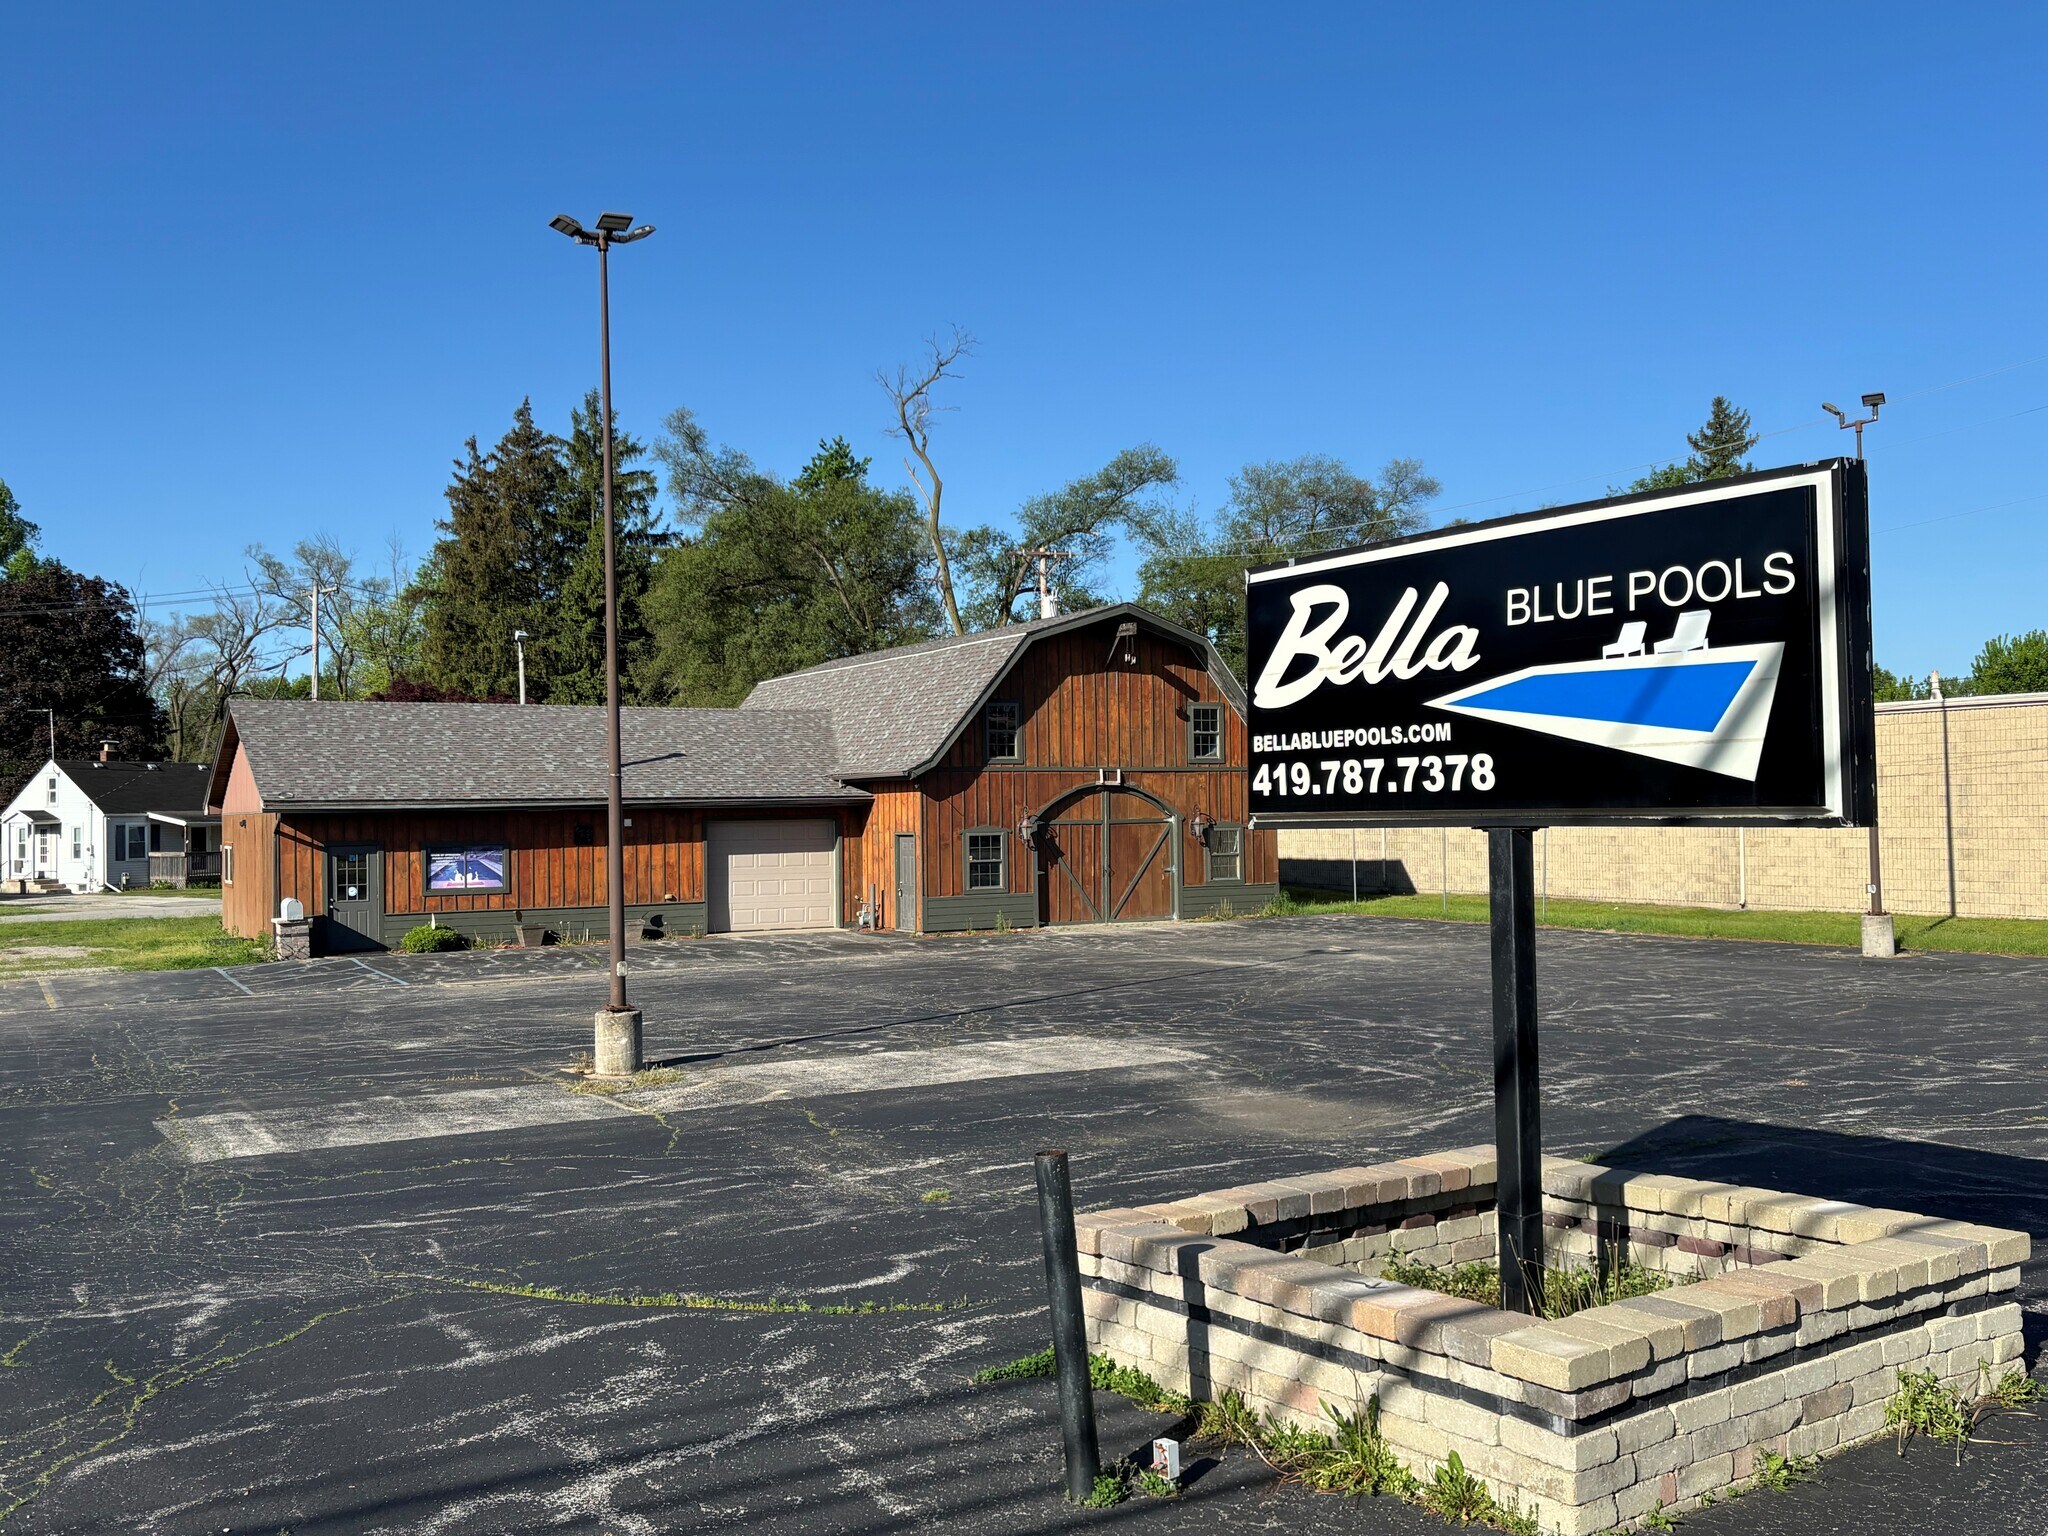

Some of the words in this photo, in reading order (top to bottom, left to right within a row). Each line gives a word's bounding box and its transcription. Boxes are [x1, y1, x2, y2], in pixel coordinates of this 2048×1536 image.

[1506, 575, 1614, 626] BLUE
[1628, 551, 1796, 612] POOLS
[1253, 581, 1481, 709] Bella
[1253, 722, 1452, 753] BELLABLUEPOOLS.COM
[1252, 752, 1496, 797] 419.787.7378
